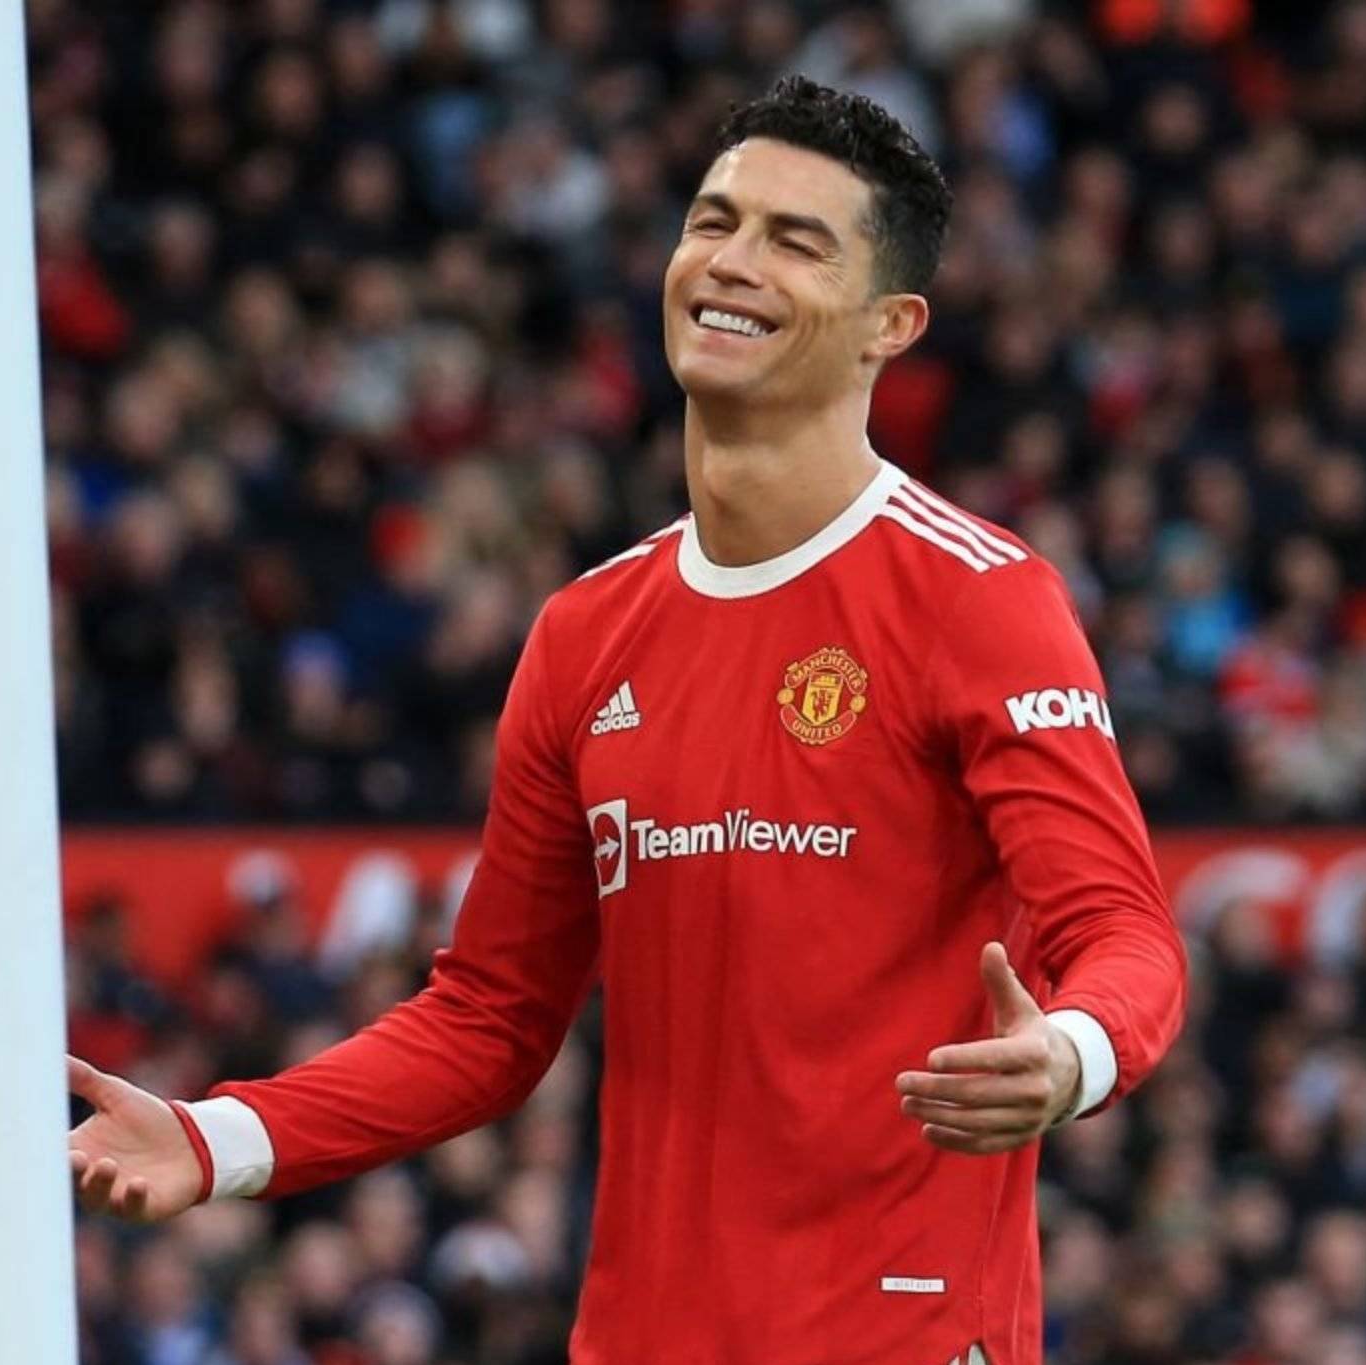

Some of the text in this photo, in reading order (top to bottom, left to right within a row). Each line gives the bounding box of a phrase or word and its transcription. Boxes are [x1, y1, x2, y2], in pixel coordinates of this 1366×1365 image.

[792, 655, 863, 690] MANCHESTER
[591, 711, 640, 735] adidas
[792, 719, 842, 739] UNITED
[631, 808, 856, 860] TeamViewer
